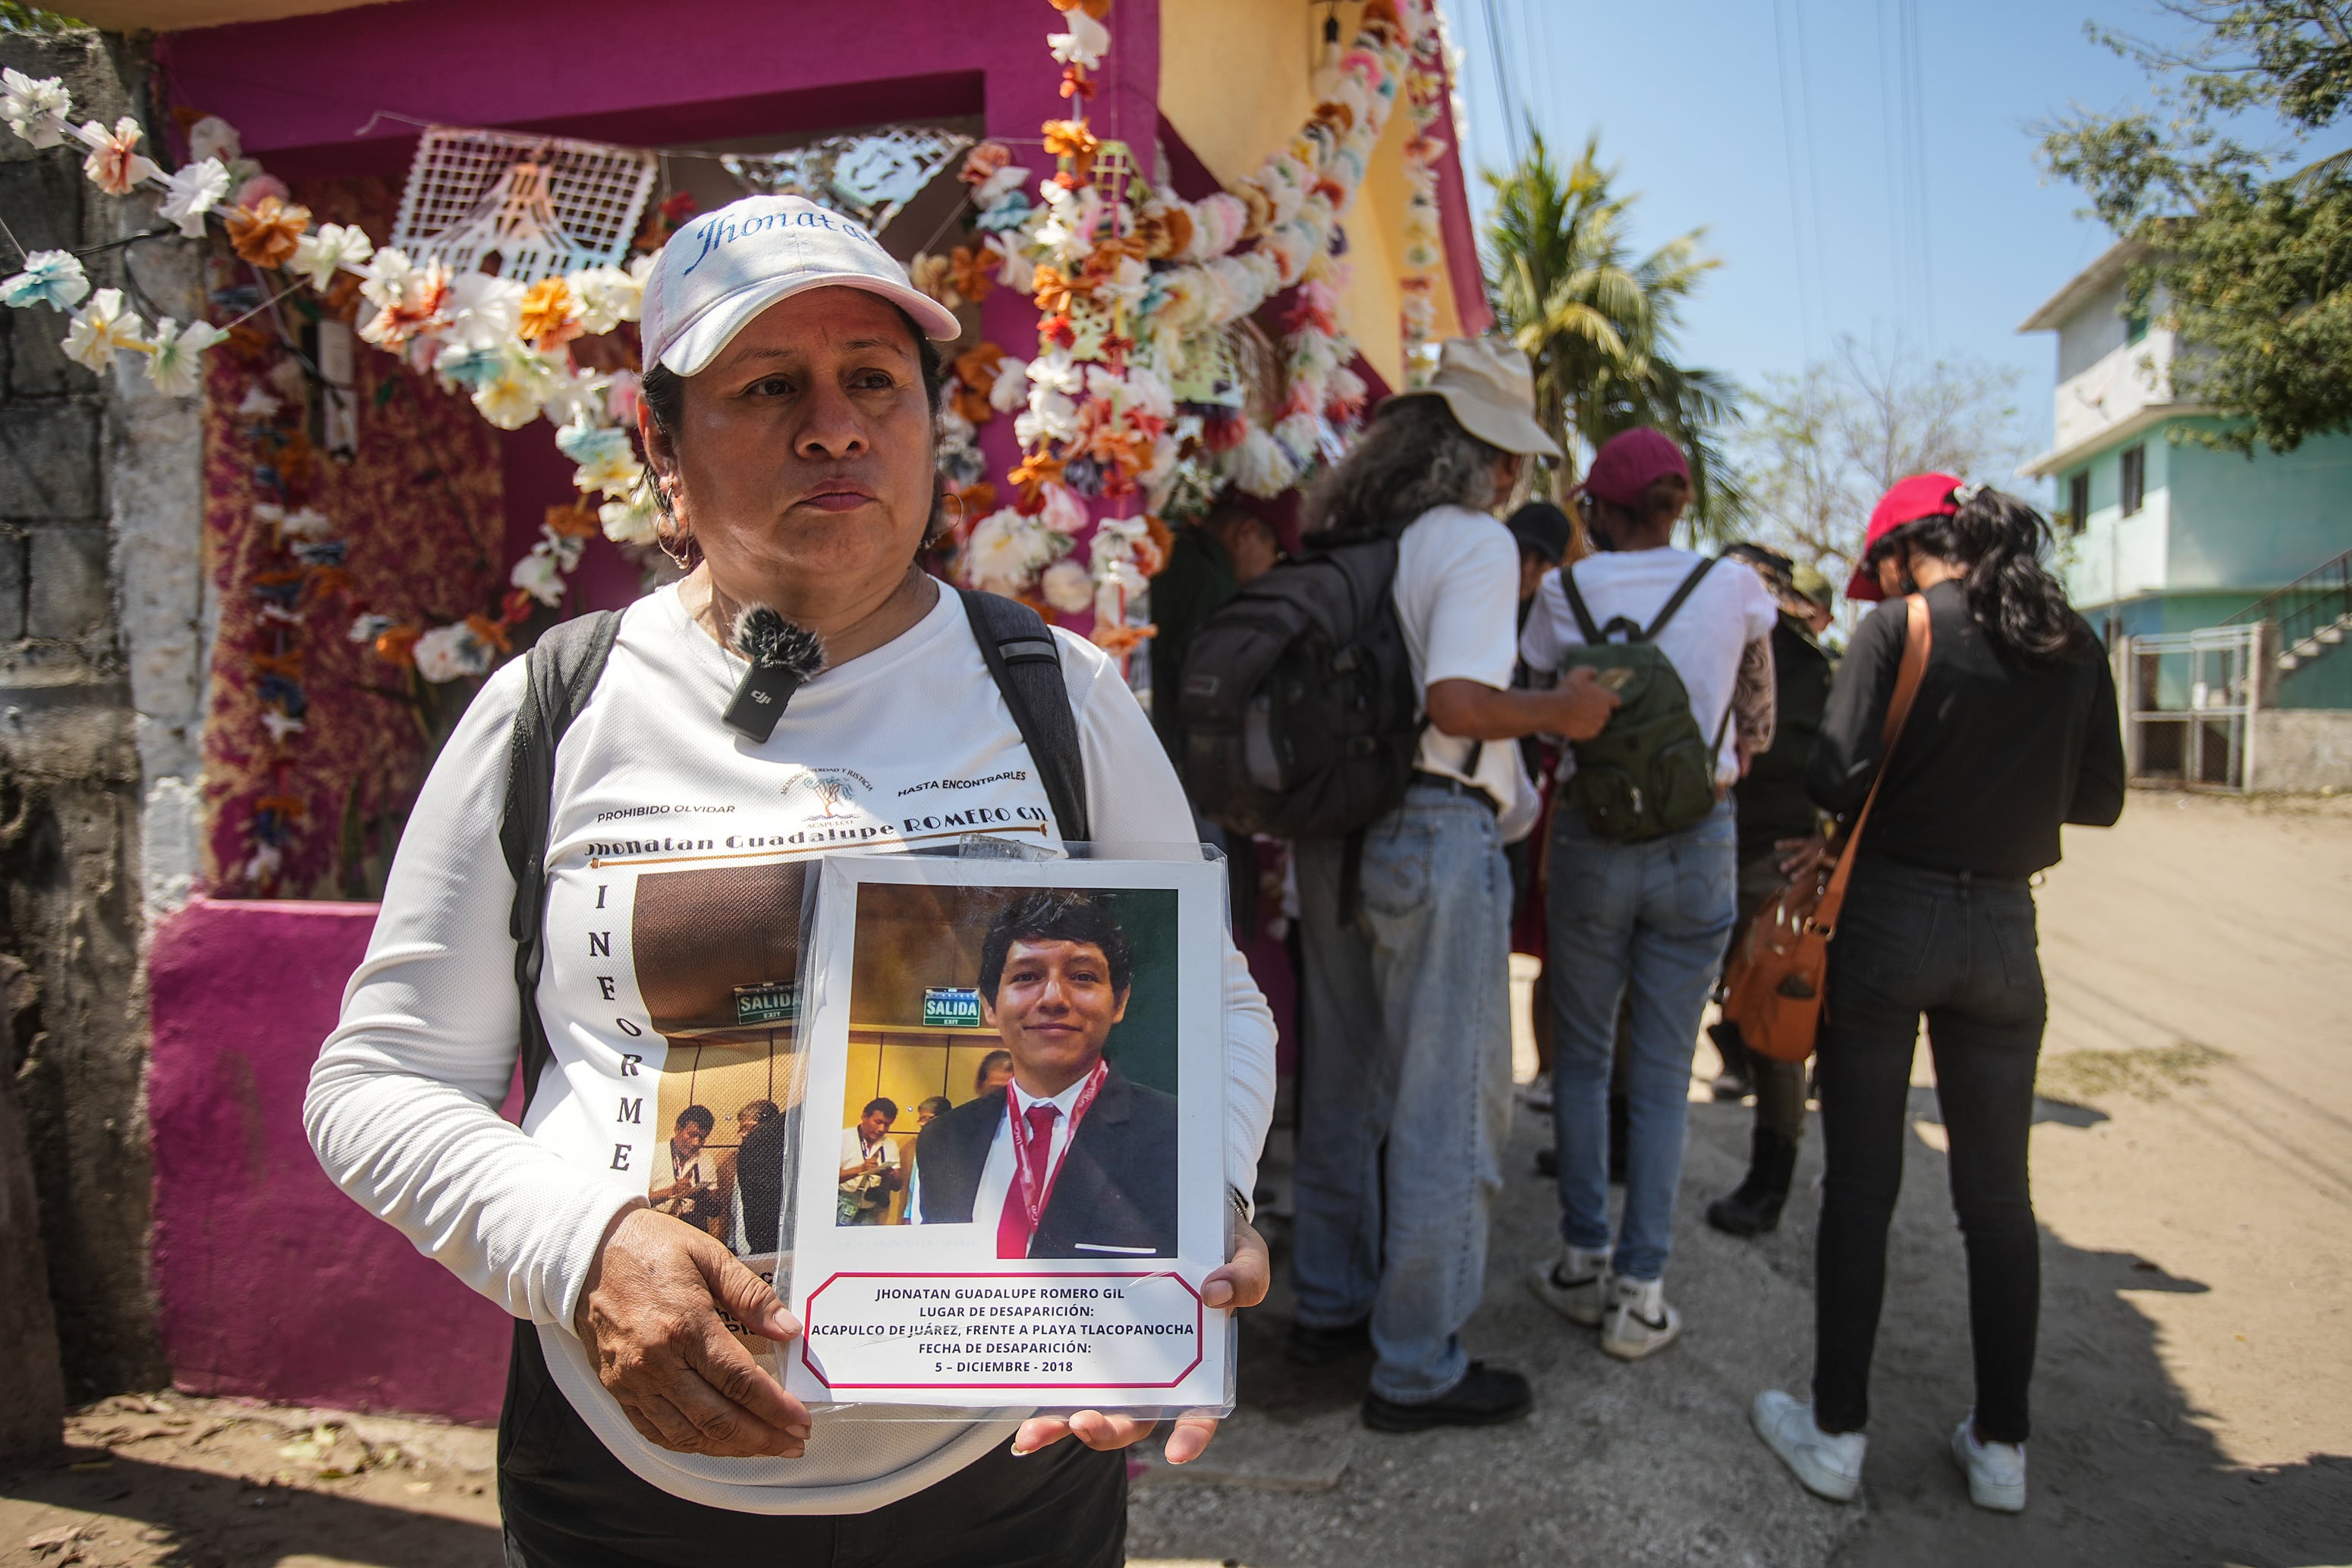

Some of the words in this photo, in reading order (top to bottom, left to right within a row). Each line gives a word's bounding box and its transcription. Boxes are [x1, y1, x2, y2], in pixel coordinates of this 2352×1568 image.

[898, 780, 939, 797] HASTA
[942, 771, 1026, 790] ENCONTRARLES
[596, 805, 671, 823] PROHIBIDO
[674, 805, 735, 813] OLVIDAR
[725, 825, 895, 849] Guadalupe
[903, 807, 1011, 833] ROMERO
[926, 1001, 978, 1017] SALIDA
[875, 1289, 949, 1301] JHONATAN
[954, 1289, 1036, 1299] GUADALUPE
[1040, 1288, 1099, 1299] ROMERO
[920, 1307, 964, 1317] LUGAR
[970, 1307, 986, 1317] DE
[989, 1304, 1094, 1317] DESAPARICIÓN:
[811, 1324, 884, 1335] ACAPULCO
[889, 1325, 905, 1335] DE
[907, 1322, 962, 1337] JUÁREZ,
[966, 1325, 1015, 1335] FRENTE
[1019, 1325, 1028, 1335] A
[1033, 1325, 1077, 1335] PLAYA
[1080, 1324, 1194, 1335] TLACOPANOCHA
[919, 1343, 961, 1353] FECHA
[966, 1343, 982, 1353] DE
[986, 1340, 1092, 1353] DESAPARICIÓN:
[935, 1362, 942, 1372] 5
[957, 1362, 1030, 1372] DICIEMBRE
[1042, 1362, 1073, 1372] 2018
